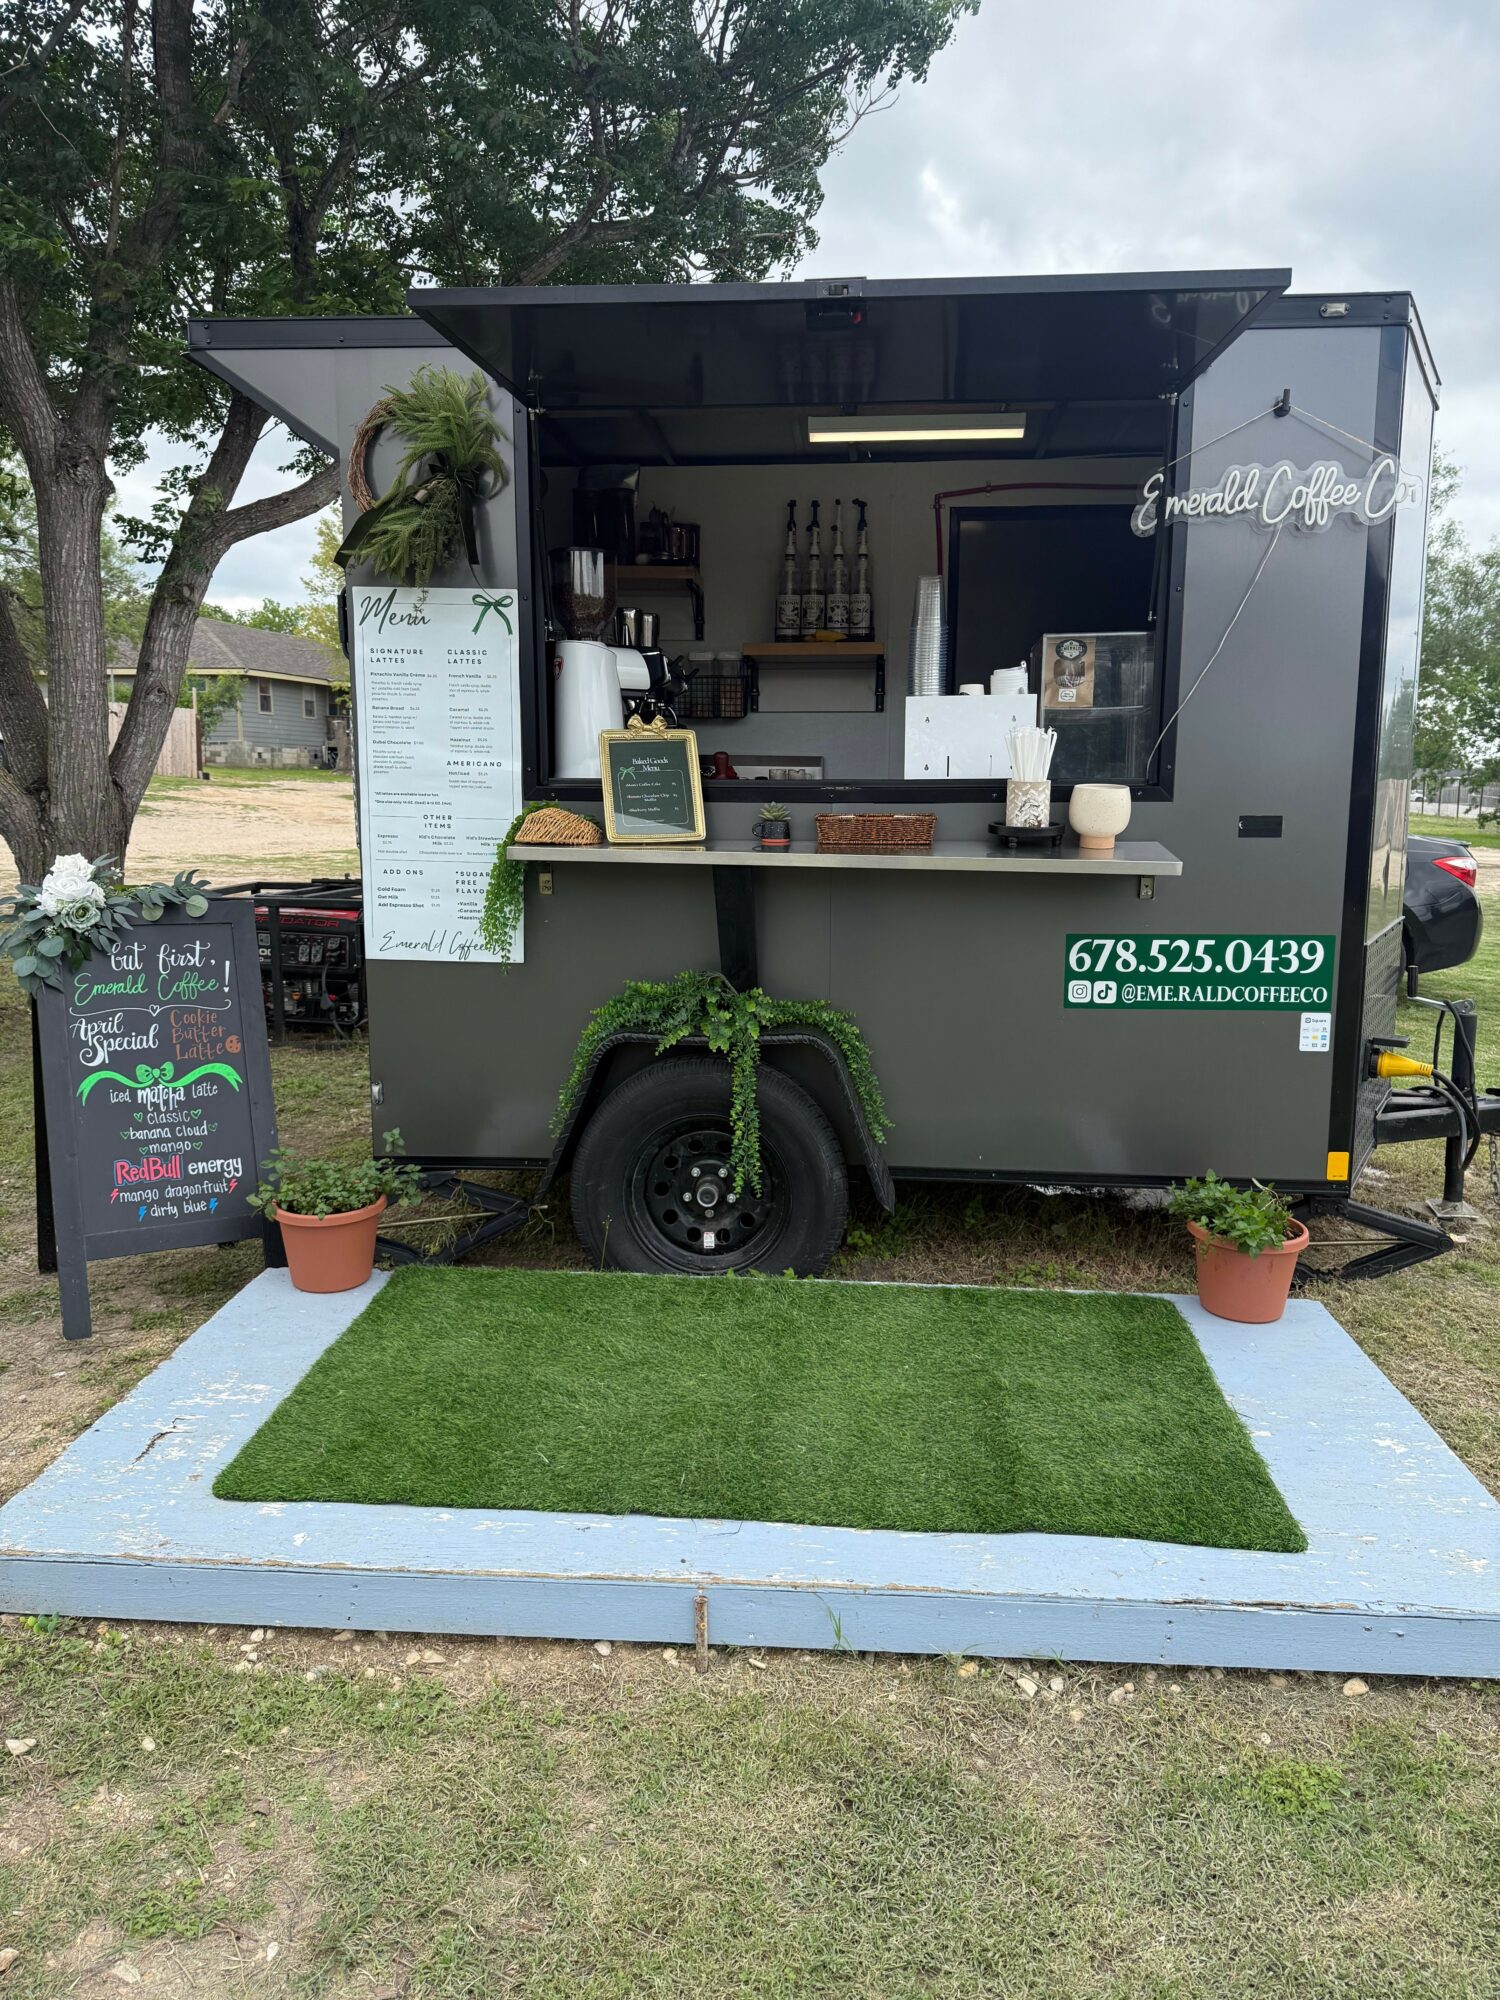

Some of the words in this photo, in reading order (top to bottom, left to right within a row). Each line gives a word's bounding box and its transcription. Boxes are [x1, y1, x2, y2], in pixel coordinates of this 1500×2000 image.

[1138, 469, 1259, 530] Emerald
[1263, 465, 1361, 526] Coffee
[358, 588, 431, 635] Menu
[369, 648, 425, 656] SIGNATURE
[632, 757, 649, 765] Baked
[649, 756, 669, 764] Goods
[642, 764, 660, 772] Menu
[379, 929, 447, 955] Emerald
[450, 931, 486, 961] Coffee
[110, 942, 146, 971] but
[158, 940, 216, 974] first,
[1068, 938, 1325, 974] 678.525.0439
[73, 972, 149, 1006] Emerald
[1121, 983, 1328, 1004] @EME.RALDCOFFEECO
[69, 1012, 124, 1043] April
[169, 1007, 218, 1027] Cookie
[171, 1024, 227, 1044] Butter
[79, 1023, 159, 1067] Special
[175, 1042, 223, 1062] Latte
[109, 1088, 132, 1104] iced
[137, 1083, 186, 1111] matcha
[192, 1082, 219, 1098] latte
[147, 1108, 191, 1124] classic
[129, 1123, 172, 1140] banana
[175, 1120, 208, 1137] cloud
[149, 1140, 192, 1157] mango
[187, 1156, 243, 1178] energy
[119, 1187, 159, 1204] mango
[164, 1179, 229, 1200] dragonfruit
[150, 1203, 178, 1219] dirty
[183, 1199, 208, 1215] blue
